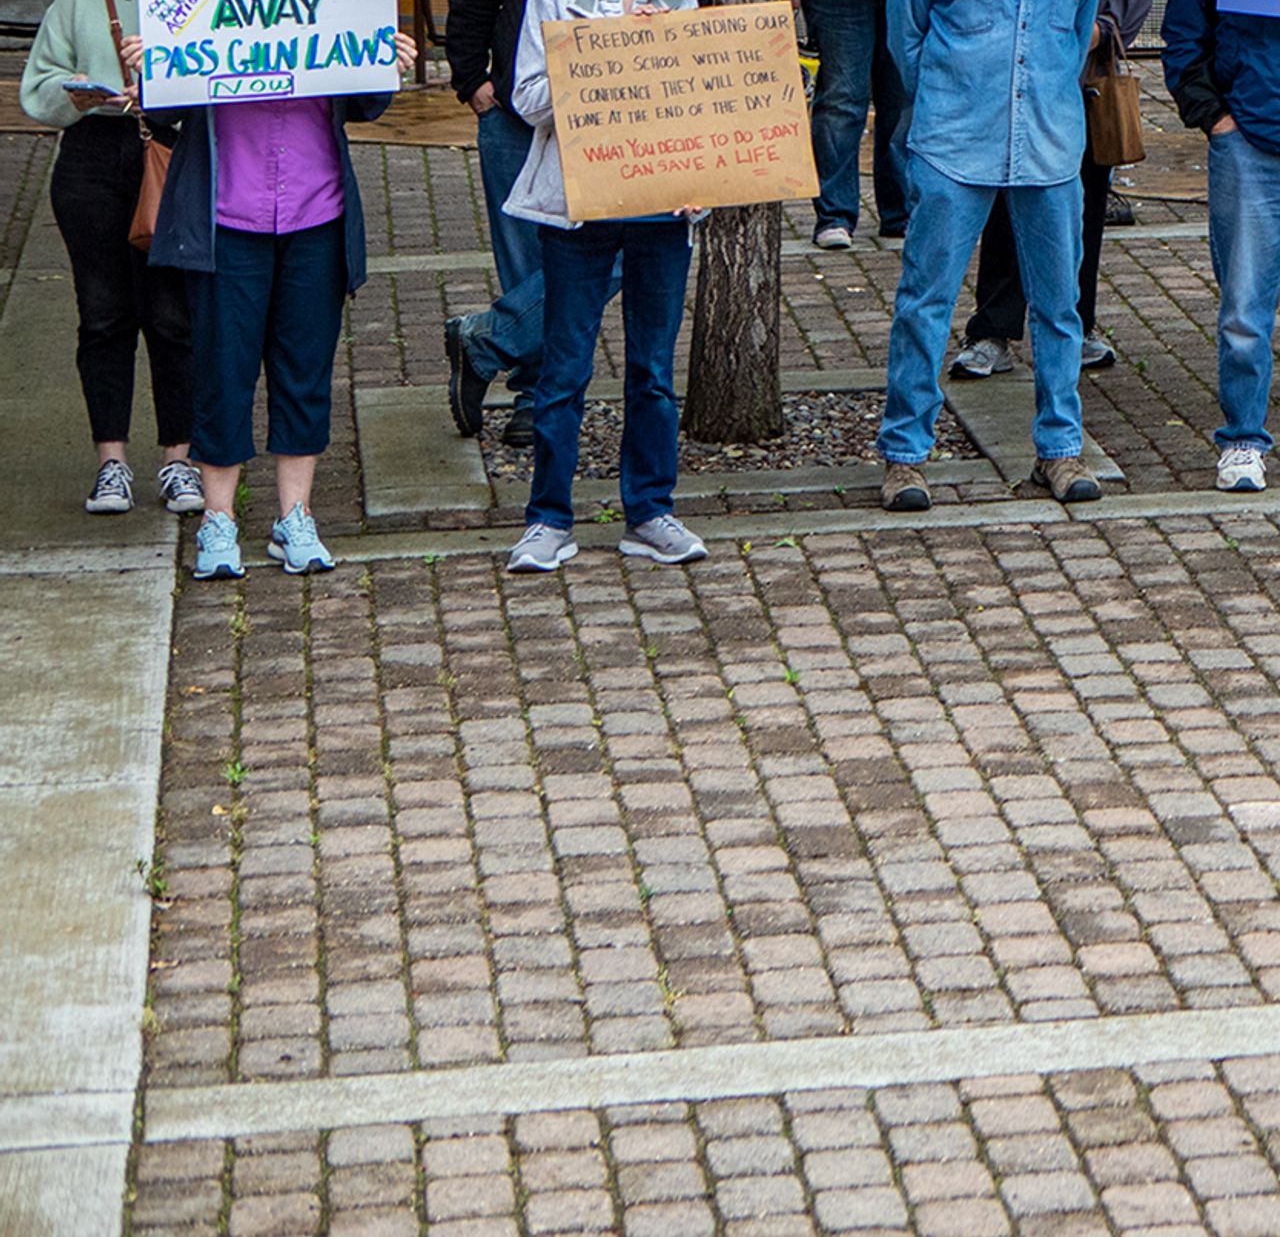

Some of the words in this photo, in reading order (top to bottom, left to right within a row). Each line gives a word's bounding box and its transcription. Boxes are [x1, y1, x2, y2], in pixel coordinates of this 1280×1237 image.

[665, 28, 677, 42] IS
[683, 16, 747, 37] SENDING
[755, 14, 790, 30] OUR
[144, 39, 219, 80] PASS
[228, 36, 298, 74] GUN
[305, 26, 398, 70] LAWS
[569, 61, 603, 79] KIDS
[607, 60, 624, 74] TO
[633, 55, 680, 73] SCHOOL
[692, 51, 730, 66] WITH
[736, 49, 764, 63] THE
[213, 78, 293, 97] NOW
[580, 84, 651, 104] CONFIDENCE
[661, 77, 695, 98] THEY
[702, 74, 735, 91] WILL
[744, 71, 779, 90] COME
[567, 110, 604, 130] HOME
[608, 110, 622, 125] AT
[627, 108, 648, 123] THE
[656, 103, 684, 120] END
[688, 102, 704, 116] OF
[712, 99, 738, 114] THE
[745, 94, 772, 111] DAY
[583, 144, 625, 163] WHAT
[658, 136, 704, 154] DECIDE
[709, 134, 729, 147] TO
[733, 129, 754, 145] DO
[761, 122, 800, 140] TODAY
[620, 162, 655, 181] CAN
[659, 156, 706, 173] SAVE
[716, 154, 727, 168] A
[735, 145, 781, 165] LIFE
